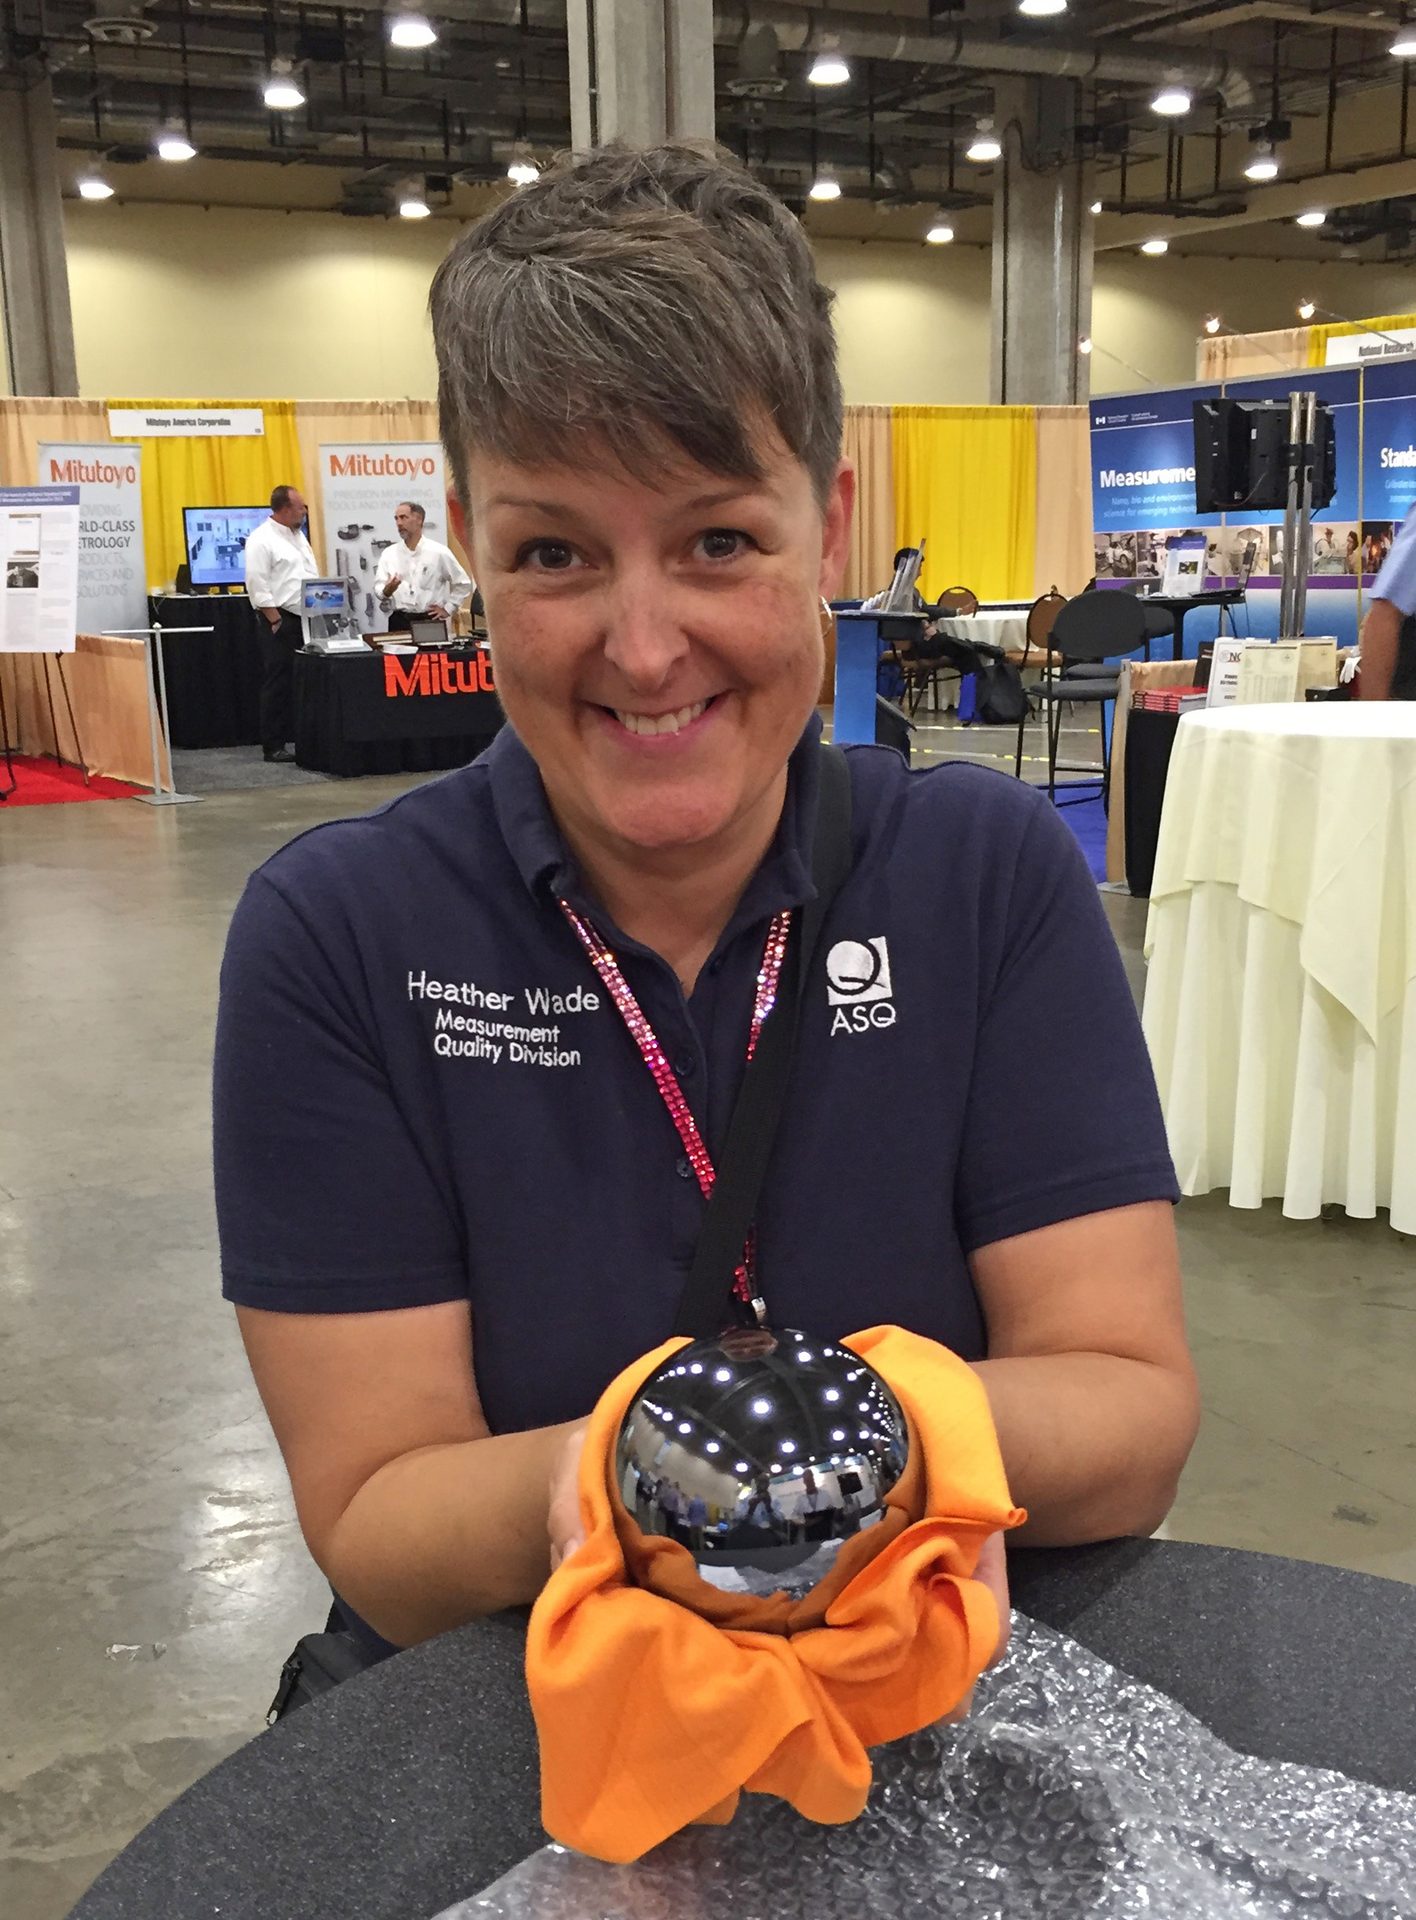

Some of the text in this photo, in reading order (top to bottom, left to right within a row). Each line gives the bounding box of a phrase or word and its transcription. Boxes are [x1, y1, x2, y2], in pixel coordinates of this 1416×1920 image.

[50, 459, 136, 489] Mitutoyo
[329, 454, 435, 481] Mitutoyo
[407, 970, 600, 1016] Heather Wade
[434, 1007, 561, 1043] Measurement
[829, 1002, 897, 1037] ASQ
[433, 1033, 582, 1067] Quality Division
